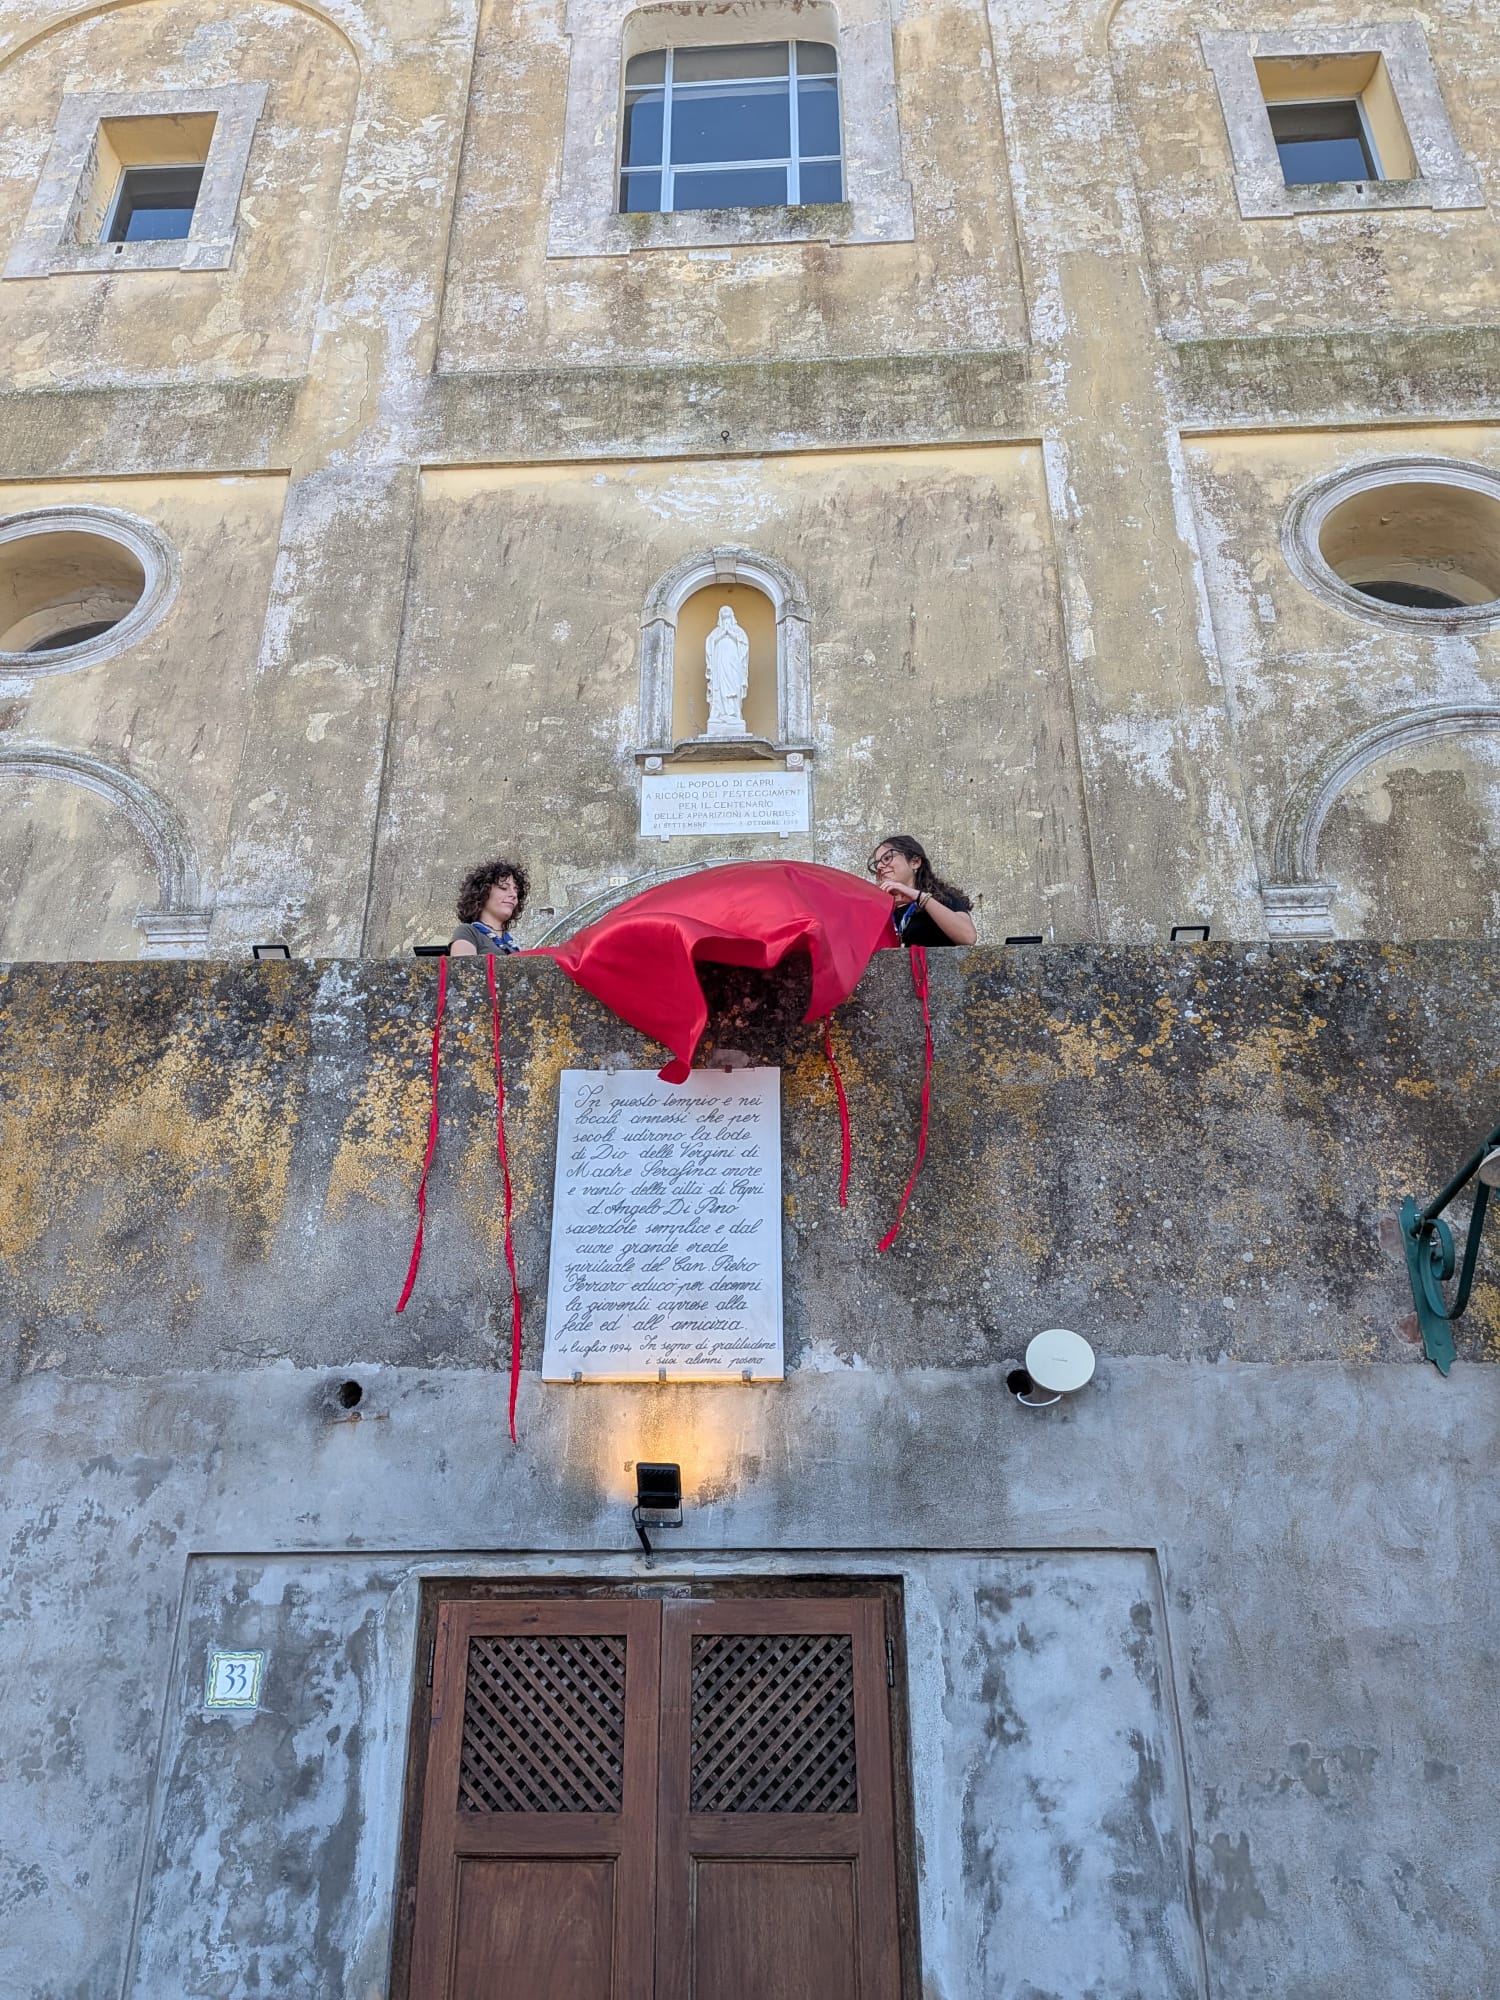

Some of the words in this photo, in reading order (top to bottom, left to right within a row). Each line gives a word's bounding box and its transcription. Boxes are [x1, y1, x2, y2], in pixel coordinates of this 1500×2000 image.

[656, 791, 699, 799] RICORDO
[689, 780, 729, 788] POPOLO
[654, 812, 683, 820] DELLE
[688, 811, 741, 819] APPARIZIONI
[575, 1085, 603, 1107] In
[610, 1093, 658, 1113] questo
[663, 1093, 718, 1112] tempio
[722, 1096, 730, 1106] e
[738, 1095, 763, 1106] nei
[575, 1109, 622, 1124] locali
[629, 1112, 689, 1124] annessi
[695, 1109, 724, 1123] che
[728, 1113, 760, 1127] per
[573, 1128, 617, 1142] secoli
[623, 1128, 687, 1142] udirono
[691, 1126, 712, 1141] la
[716, 1126, 751, 1140] lode
[571, 1146, 587, 1160] di
[590, 1144, 629, 1160] Dio
[639, 1144, 674, 1159] delle
[680, 1142, 736, 1165] Vergini
[741, 1144, 760, 1158] di
[566, 1162, 633, 1177] Madre
[641, 1160, 717, 1185] Serafina
[722, 1167, 762, 1177] onore
[567, 1185, 576, 1195] e
[582, 1182, 626, 1195] vanto
[630, 1180, 666, 1195] della
[708, 1180, 724, 1195] di
[729, 1179, 765, 1201] Capri
[664, 1198, 690, 1214] Di
[694, 1197, 739, 1214] Pino
[565, 1217, 639, 1234] sacerdote
[645, 1217, 711, 1239] semplice
[715, 1224, 724, 1233] e
[729, 1219, 763, 1233] dal
[576, 1243, 614, 1253] cuore
[616, 1237, 679, 1261] grande
[687, 1237, 728, 1253] erede
[564, 1257, 635, 1278] spirituale
[641, 1256, 671, 1272] del
[712, 1255, 760, 1271] Pietro
[563, 1273, 629, 1293] Ferraro
[677, 1280, 705, 1296] per
[708, 1274, 763, 1291] decenni
[565, 1296, 582, 1311] la
[657, 1298, 709, 1318] caprese
[715, 1295, 748, 1310] alla
[554, 1314, 594, 1341] fede
[559, 1342, 568, 1353] 4
[570, 1340, 606, 1358] luglio
[609, 1343, 632, 1353] 1994
[640, 1335, 658, 1350] In
[660, 1339, 692, 1355] segno
[695, 1339, 710, 1350] di
[711, 1336, 776, 1355] gratitudine
[646, 1355, 651, 1365] i
[657, 1355, 679, 1364] suoi
[728, 1357, 765, 1367] posero
[222, 1663, 246, 1695] 33
